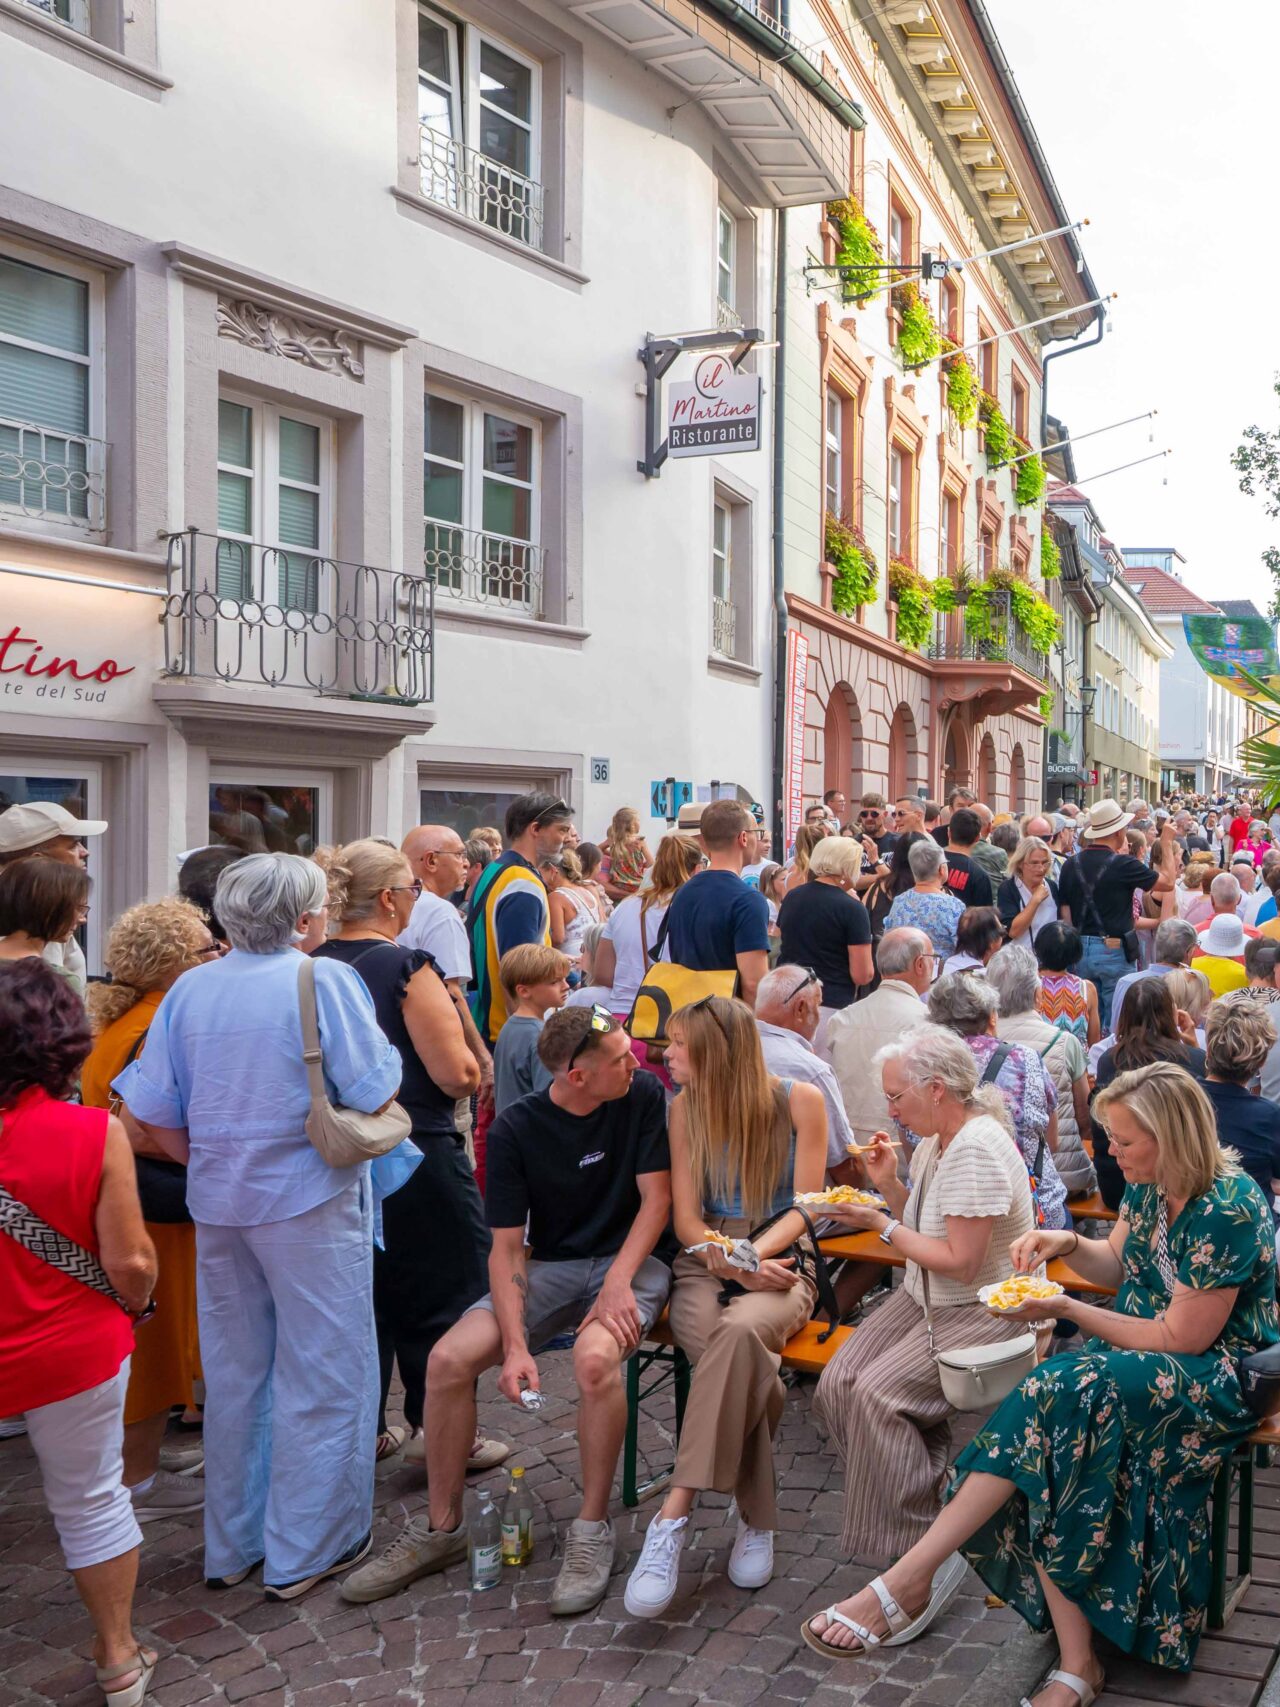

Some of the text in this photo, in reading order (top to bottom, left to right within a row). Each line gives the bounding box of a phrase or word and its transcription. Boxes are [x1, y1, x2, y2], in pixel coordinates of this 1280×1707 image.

[702, 363, 724, 389] il
[672, 396, 757, 427] Martino
[672, 423, 754, 446] Ristorante
[36, 684, 66, 699] del
[73, 687, 107, 703] Sud
[595, 764, 608, 780] 36
[1047, 763, 1077, 773] BÜCHER
